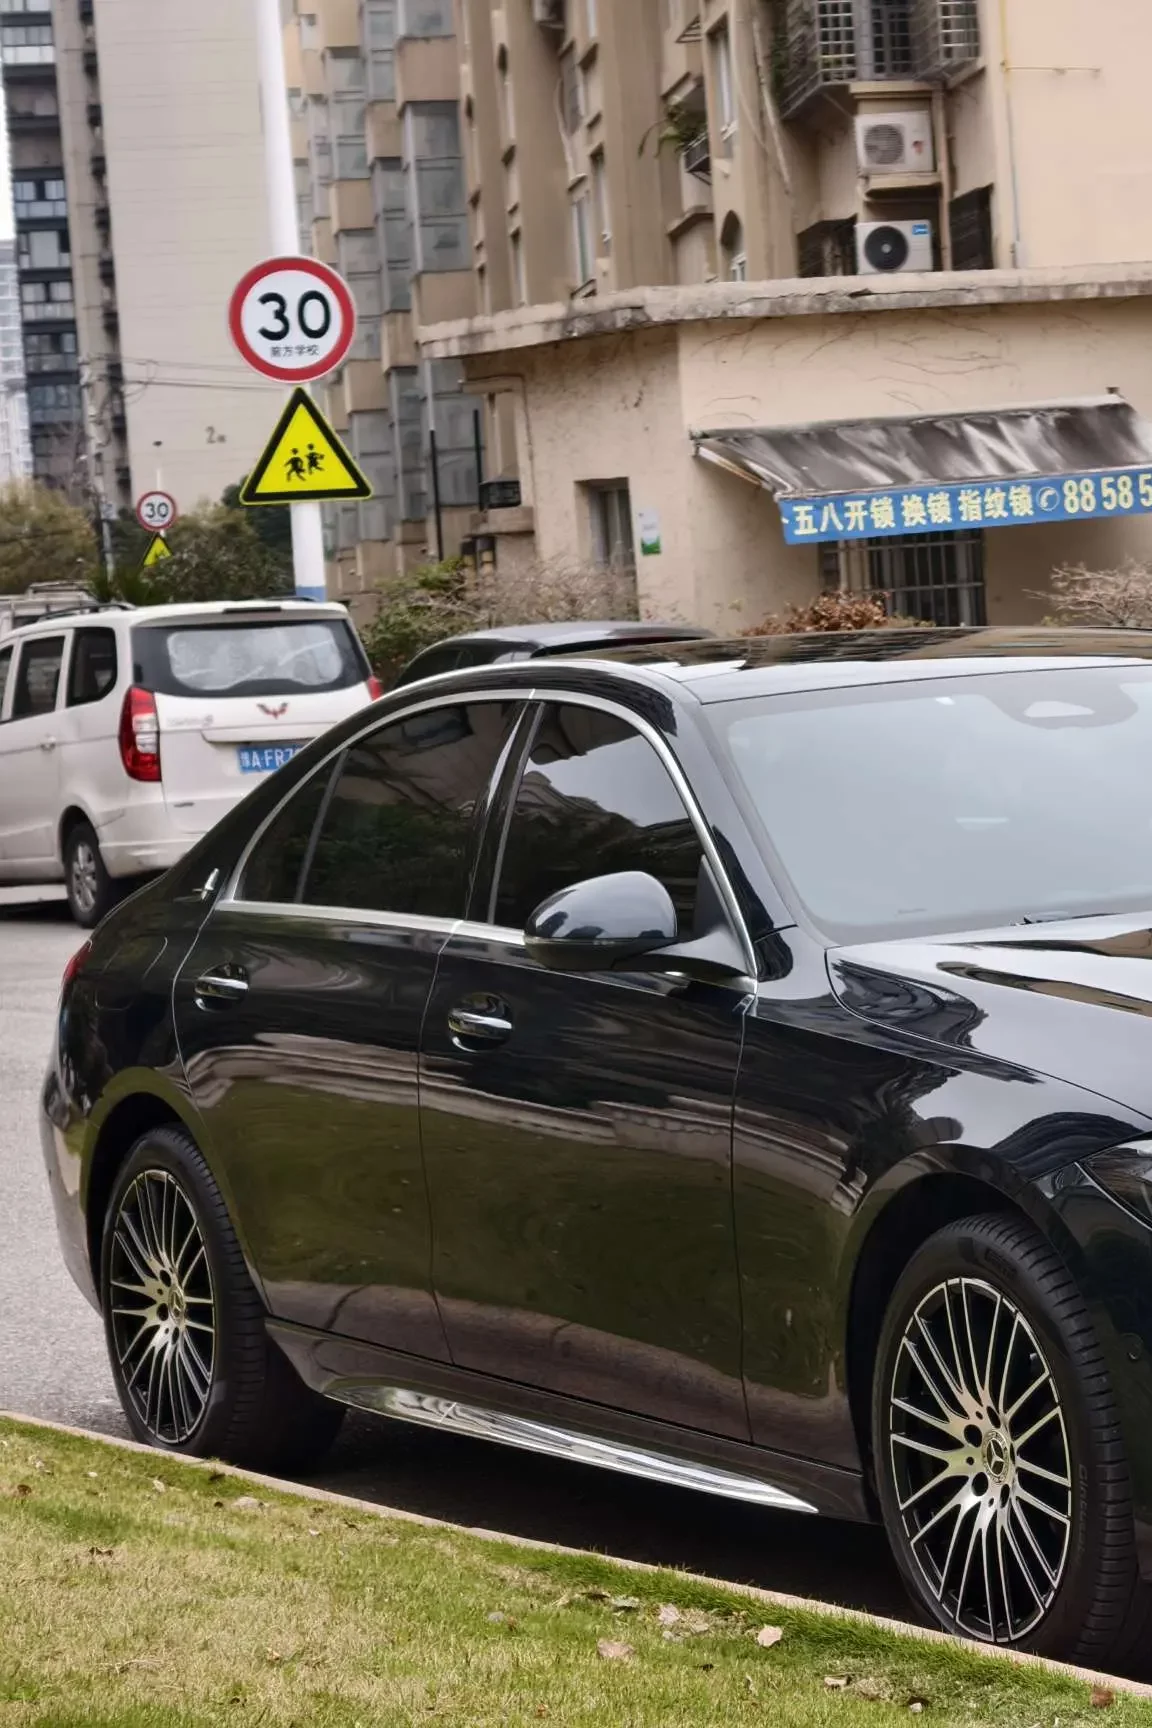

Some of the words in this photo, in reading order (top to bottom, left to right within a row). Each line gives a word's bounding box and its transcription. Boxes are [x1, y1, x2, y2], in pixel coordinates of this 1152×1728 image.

[257, 290, 331, 341] 30
[144, 502, 170, 519] 30
[792, 496, 896, 535] 五八开锁
[901, 491, 953, 526] 换锁
[957, 484, 1035, 522] 指纹锁
